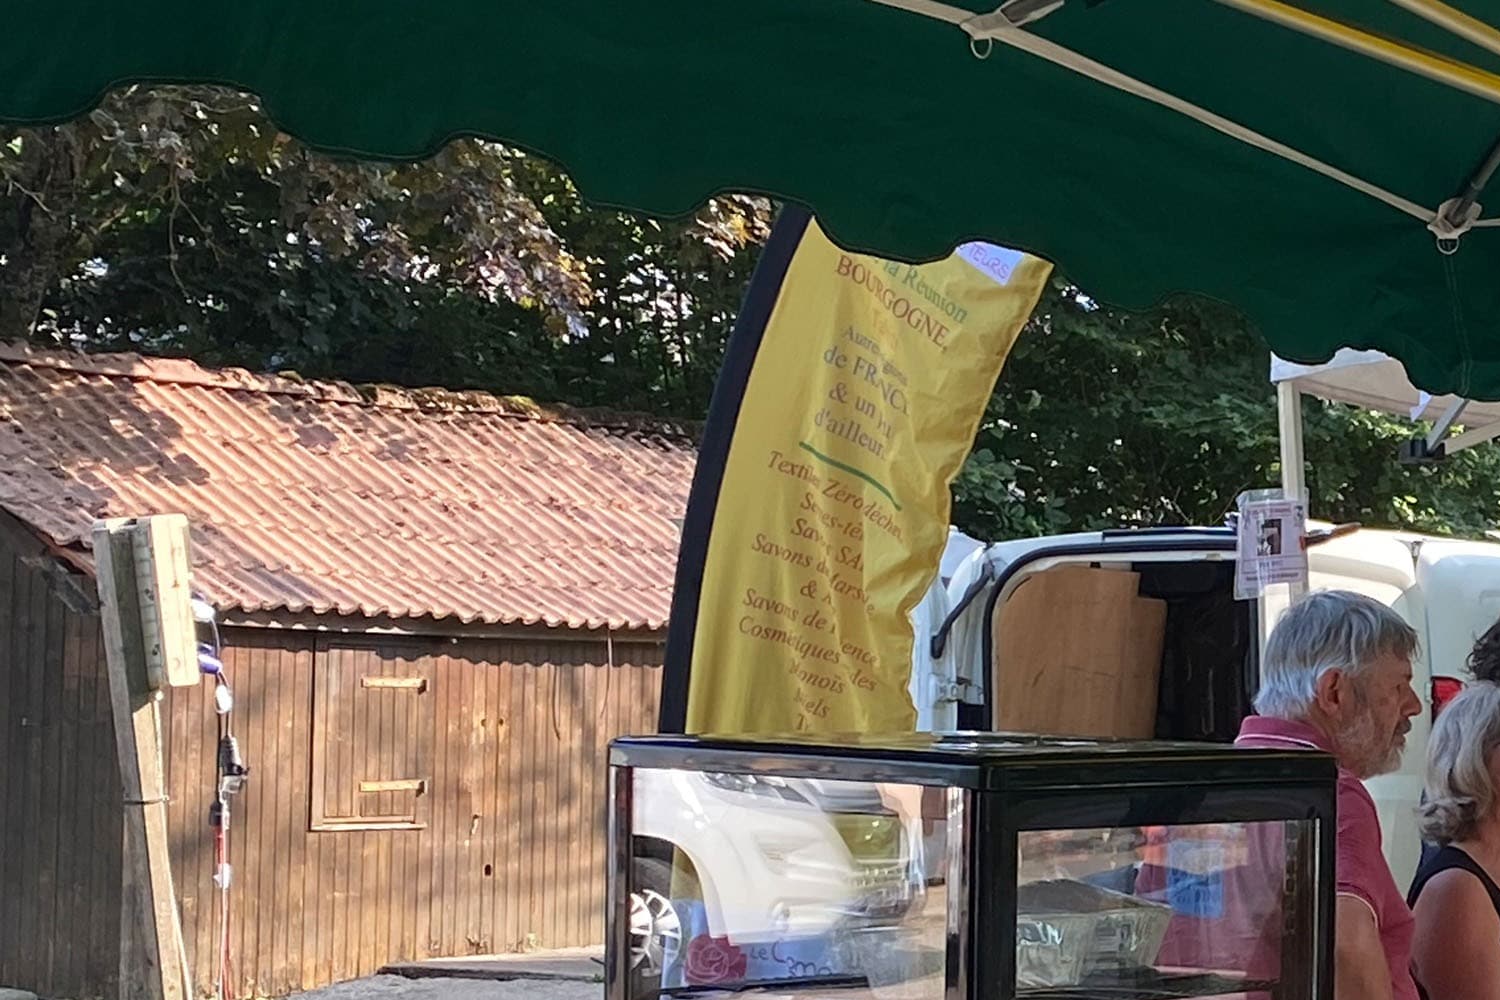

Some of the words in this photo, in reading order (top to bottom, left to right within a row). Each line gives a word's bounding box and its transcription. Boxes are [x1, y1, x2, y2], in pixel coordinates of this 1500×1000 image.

[901, 264, 969, 324] Réunion
[823, 345, 848, 369] de
[828, 382, 848, 404] &
[855, 396, 877, 419] un
[814, 408, 887, 461] d'ailleur
[751, 533, 813, 568] Savons
[799, 579, 817, 600] &
[741, 588, 800, 622] Savons
[801, 610, 828, 631] de
